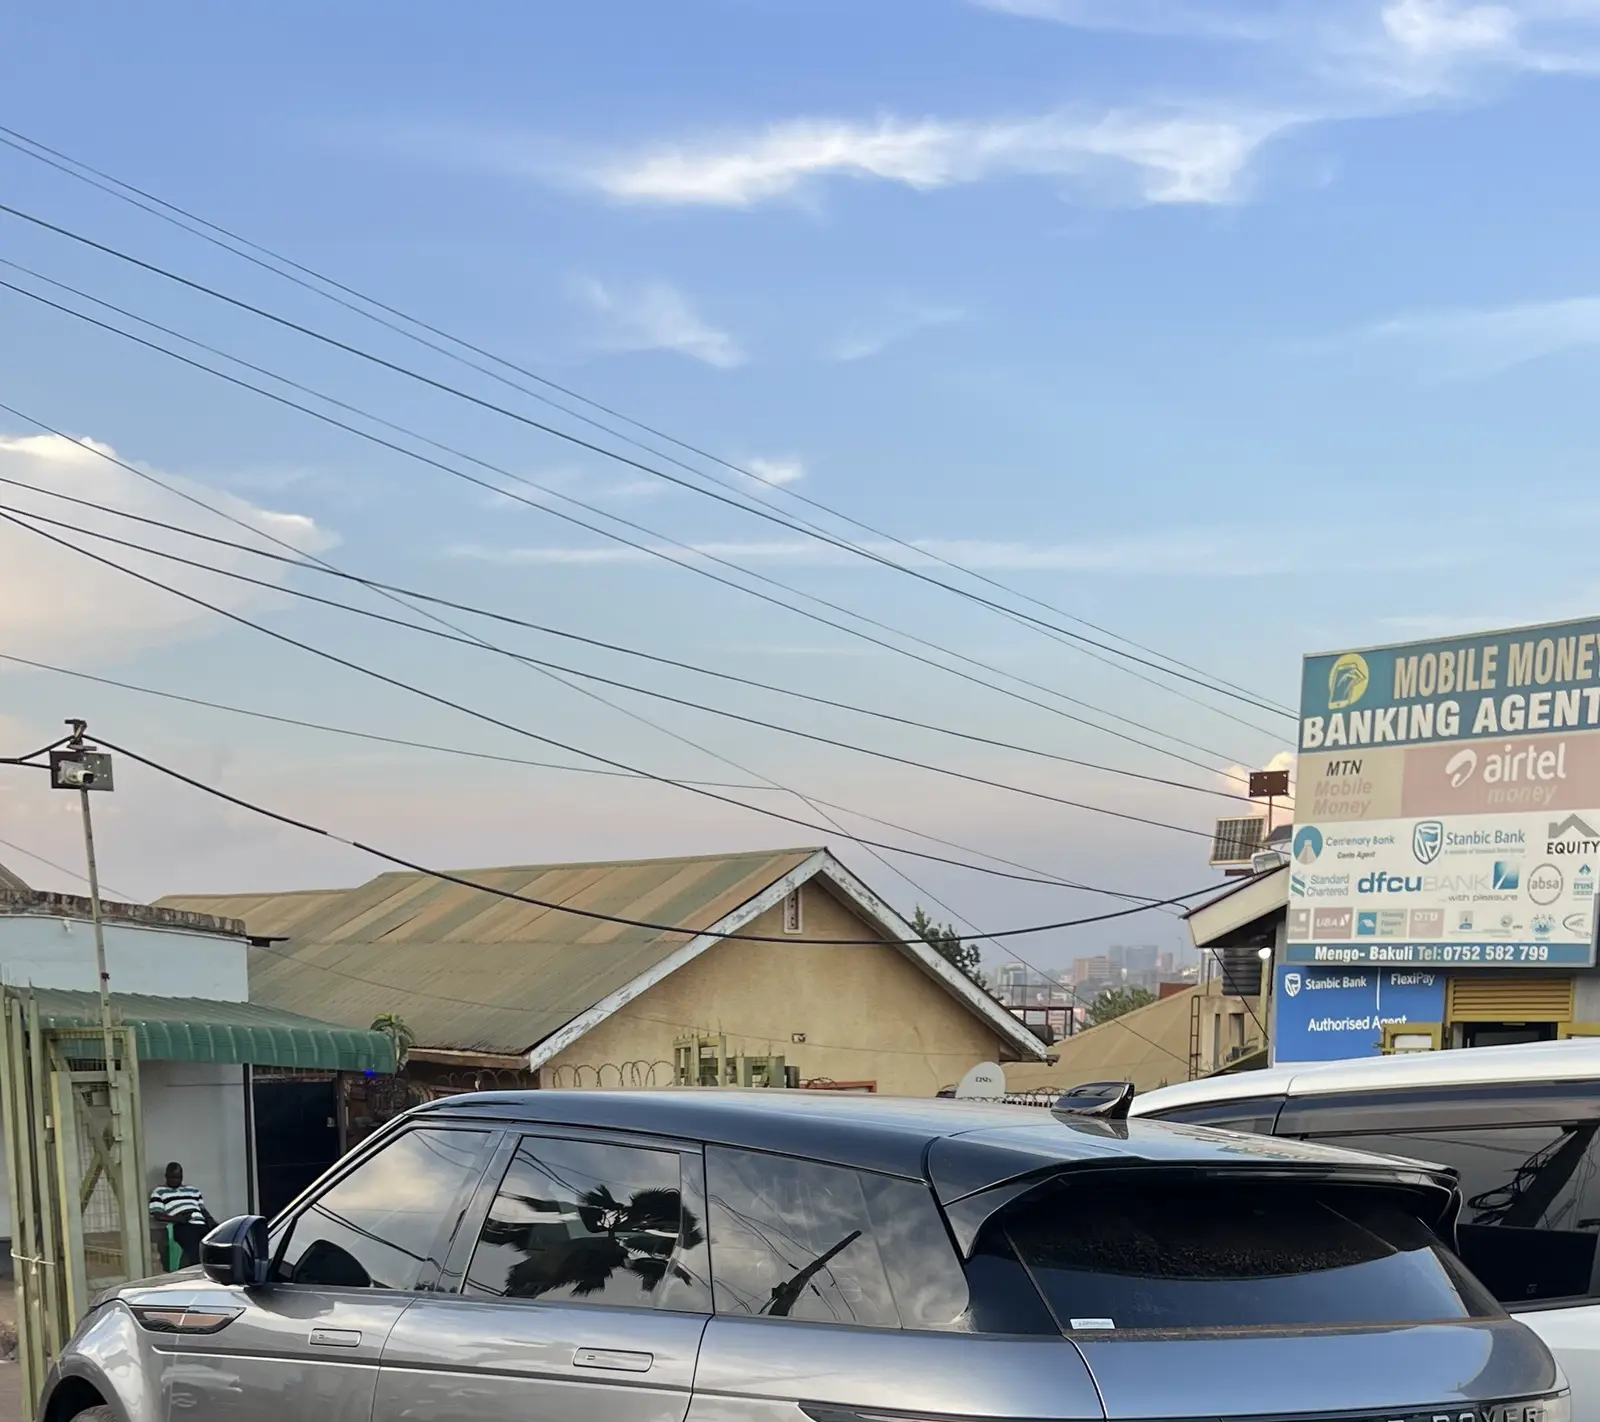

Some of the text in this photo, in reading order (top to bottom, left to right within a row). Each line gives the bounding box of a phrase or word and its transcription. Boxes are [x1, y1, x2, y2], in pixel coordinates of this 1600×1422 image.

[1393, 633, 1600, 699] MOBILE MONE
[1302, 687, 1600, 748] BANKING AGENT
[1326, 759, 1363, 776] MTN
[1483, 742, 1566, 783] airtel
[1314, 777, 1373, 798] Mobile
[1487, 784, 1558, 805] money
[1312, 798, 1371, 818] Money
[1446, 829, 1525, 846] Stanbic Bank
[1546, 841, 1600, 855] EQUITY
[1310, 874, 1350, 885] Standard
[1531, 876, 1560, 890] absa
[1307, 885, 1349, 898] Chartered
[1315, 946, 1365, 962] Mengo-
[1369, 946, 1413, 960] Bakuli
[1485, 946, 1514, 960] 582
[1519, 946, 1549, 960] 799
[1305, 975, 1367, 990] Stanbic Bank
[1391, 971, 1435, 987] FlexiPay
[1307, 1014, 1370, 1032] Authorised
